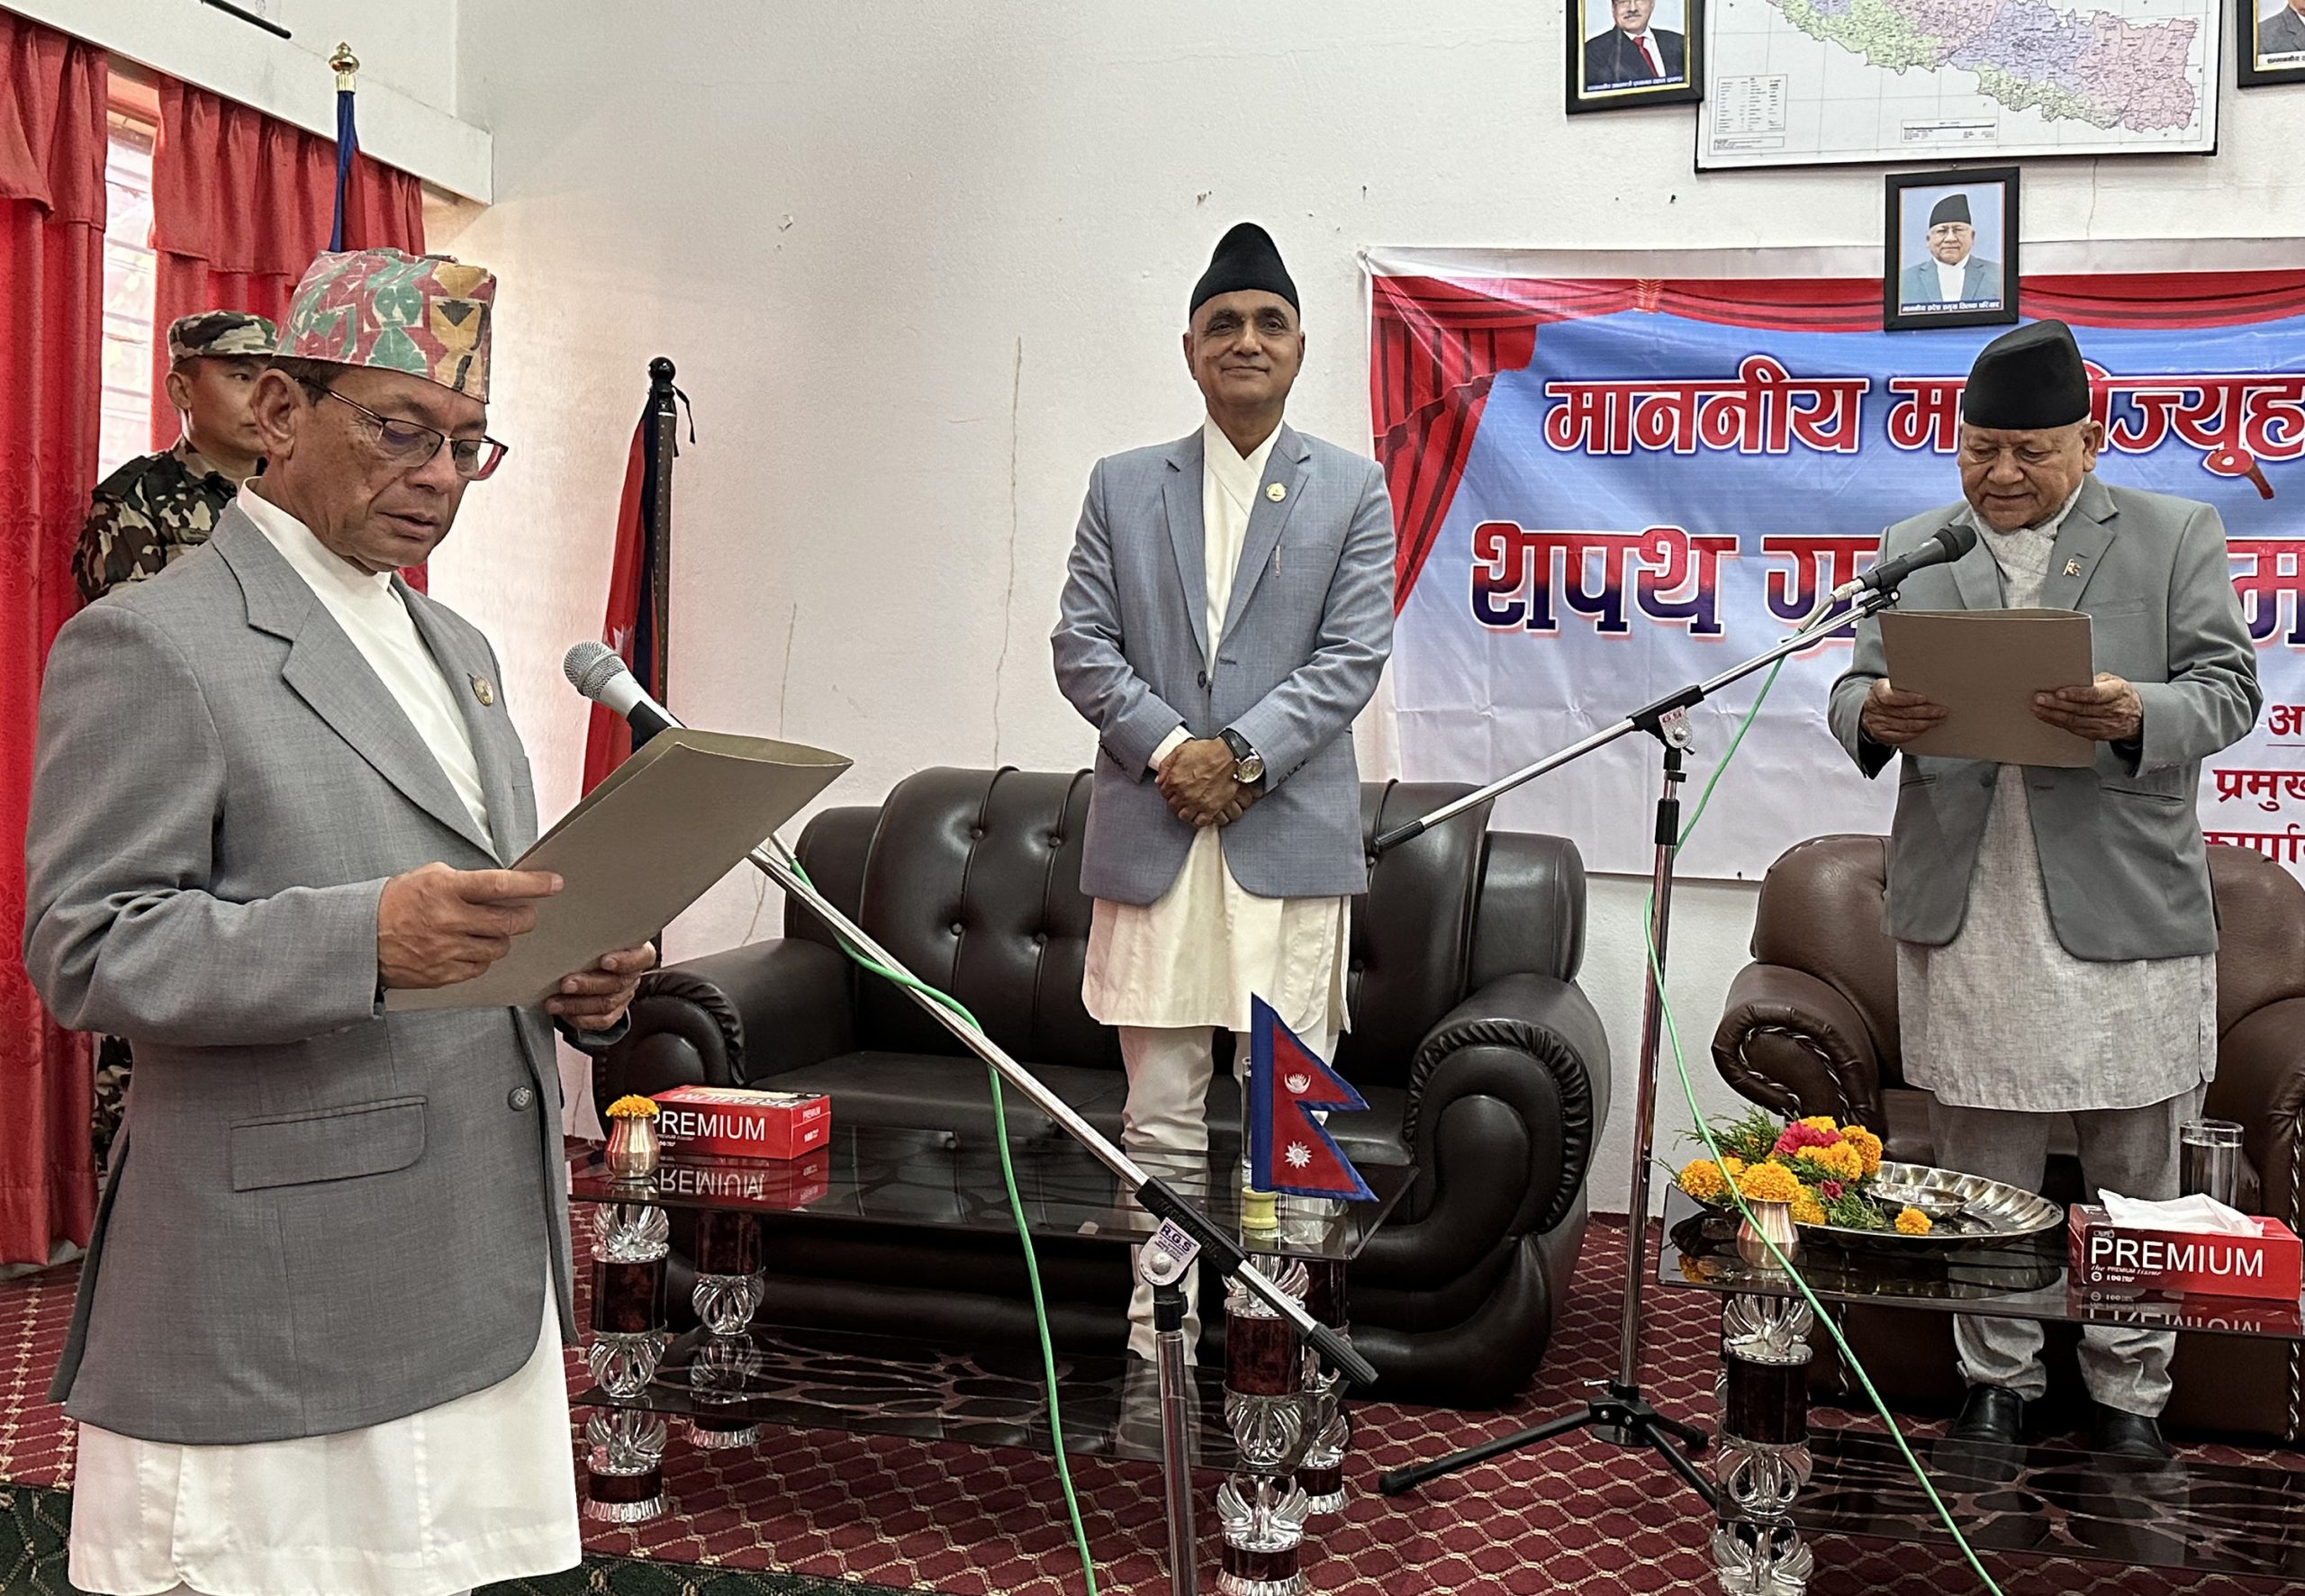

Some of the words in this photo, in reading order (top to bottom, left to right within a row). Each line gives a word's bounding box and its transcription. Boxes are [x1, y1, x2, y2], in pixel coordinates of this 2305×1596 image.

[1544, 355, 1870, 455] माननीय
[1470, 520, 1737, 636] शपथ
[2091, 1237, 2264, 1278] PREMIUM
